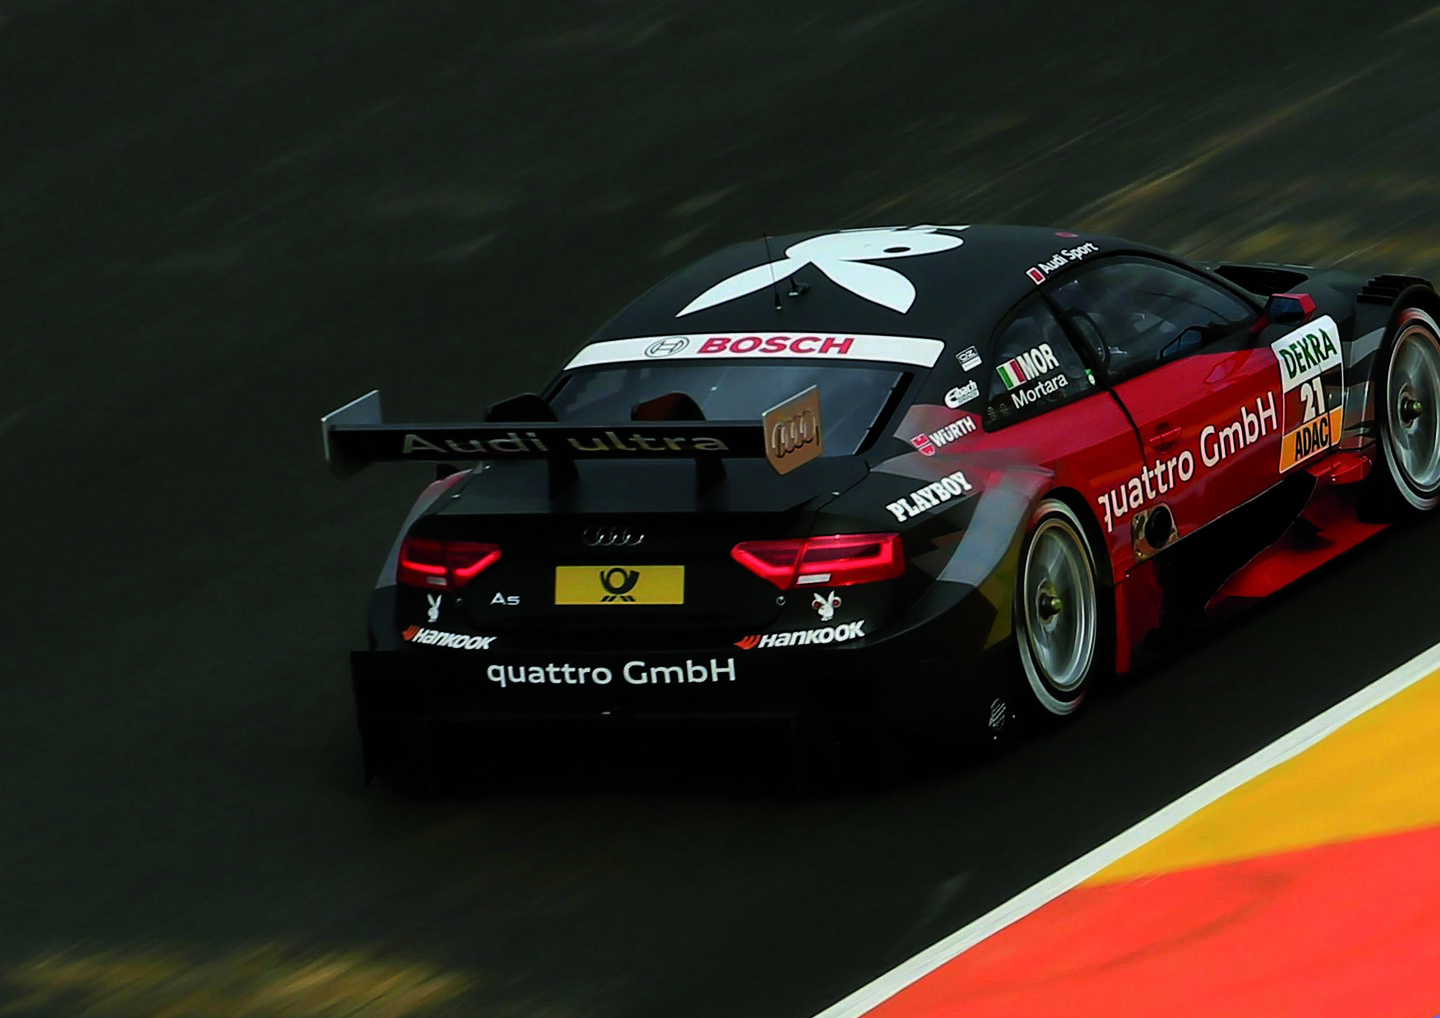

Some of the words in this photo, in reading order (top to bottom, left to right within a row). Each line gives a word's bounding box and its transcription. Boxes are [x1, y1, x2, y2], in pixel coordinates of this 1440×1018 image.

[1038, 254, 1069, 274] Audi
[1060, 242, 1099, 260] Sport
[697, 336, 855, 354] BOSCH
[1016, 343, 1060, 380] MOR
[1279, 328, 1337, 379] DEKRA
[1011, 374, 1069, 409] Mortara
[1300, 376, 1326, 424] 21
[401, 432, 549, 454] Audi
[568, 431, 730, 452] ultra
[928, 415, 977, 448] WÜRTH
[1200, 391, 1278, 468] GmbH
[1295, 417, 1329, 461] ADAC
[885, 471, 973, 523] PLAYBOY
[487, 663, 613, 688] quattro
[623, 658, 736, 685] GmbH
